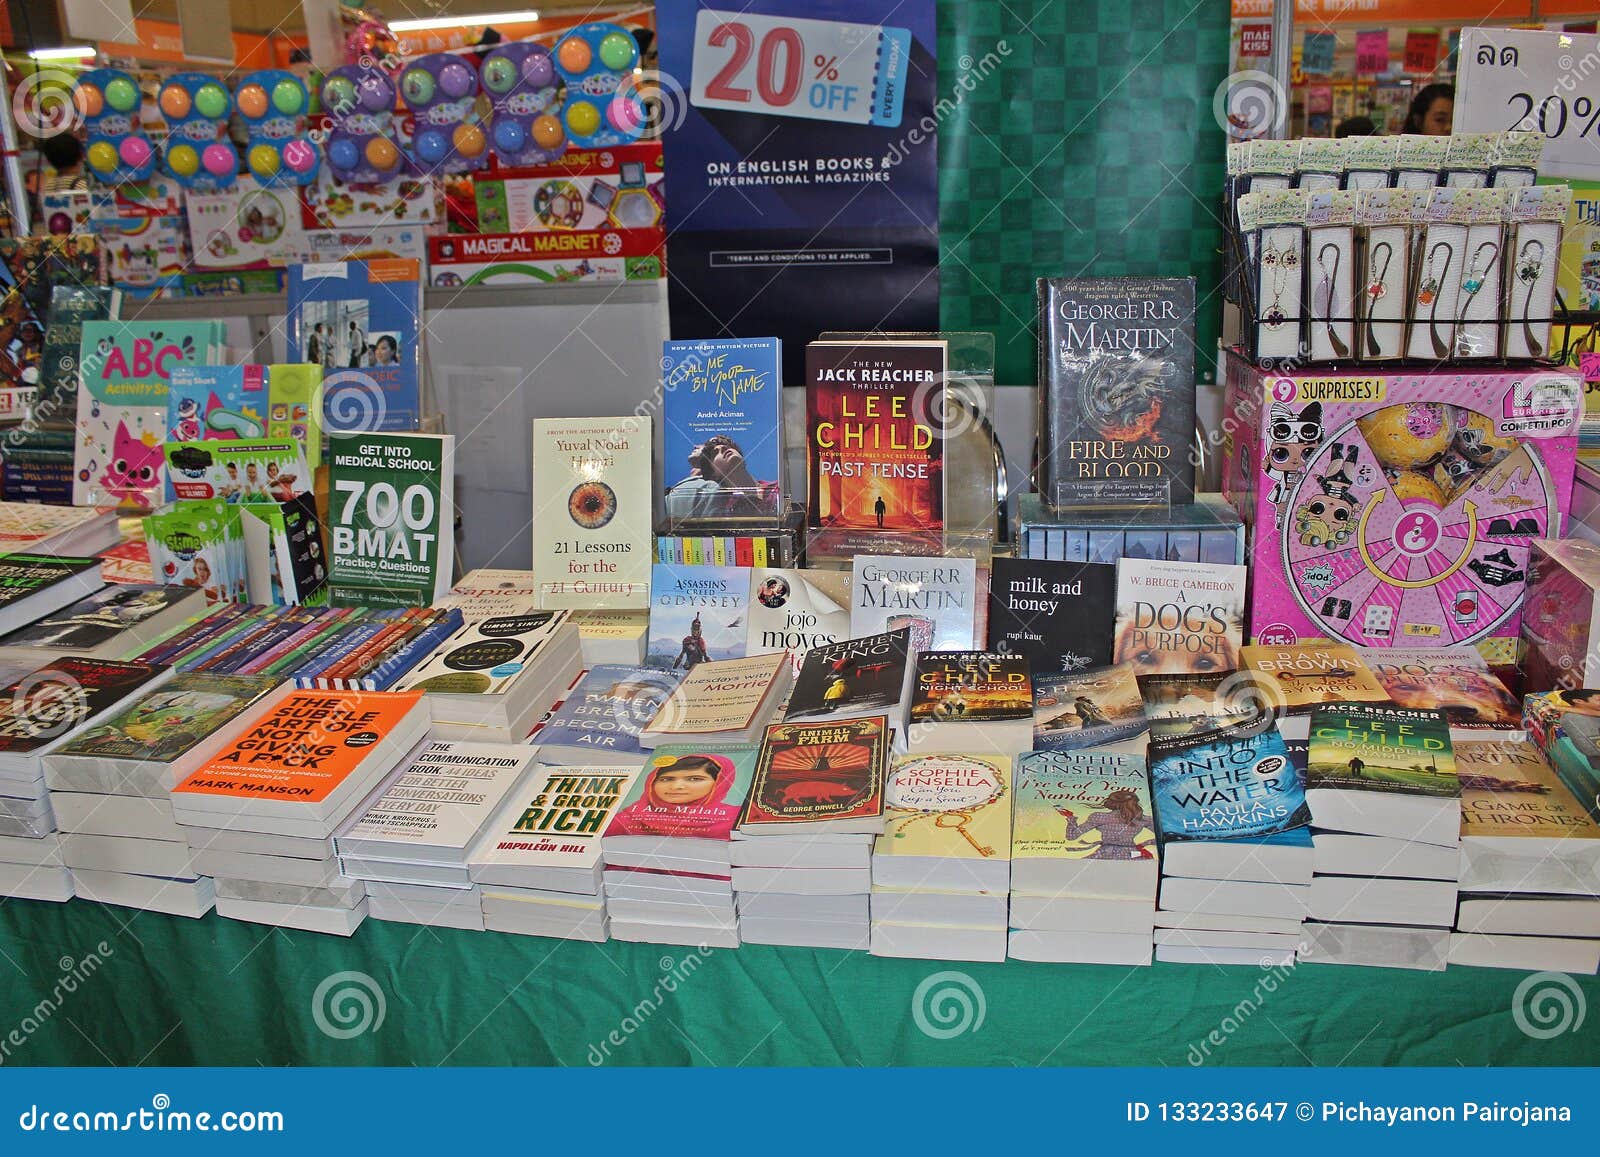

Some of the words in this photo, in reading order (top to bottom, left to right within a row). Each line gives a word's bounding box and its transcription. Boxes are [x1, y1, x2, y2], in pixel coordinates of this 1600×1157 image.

[1477, 45, 1519, 67] ลด
[704, 22, 805, 107] 20
[808, 82, 859, 112] OFF
[883, 82, 895, 118] EVERY
[707, 162, 730, 174] ON
[737, 160, 808, 173] ENGLISH
[816, 157, 874, 171] BOOKS
[708, 175, 810, 186] INTERNATIONAL
[815, 172, 890, 183] MAGAZINES
[463, 236, 532, 255] MAGICAL
[534, 234, 601, 251] MAGNET
[773, 253, 815, 262] CONDITIONS
[1060, 300, 1138, 320] GEORGE
[1066, 322, 1175, 351] MARTIN
[102, 338, 183, 379] ABC
[817, 369, 856, 382] JACK
[862, 370, 934, 382] REACHER
[1302, 381, 1380, 399] SURPRISES!
[842, 395, 906, 418] LEE
[1501, 420, 1548, 431] CONFETTI
[1551, 418, 1572, 428] POP
[816, 422, 933, 450] CHILD
[359, 445, 382, 455] GET
[385, 446, 411, 456] INTO
[556, 439, 591, 451] Yuval
[595, 438, 629, 450] Noah
[1069, 440, 1126, 459] FIRE
[1132, 446, 1171, 459] AND
[335, 455, 385, 468] MEDICAL
[388, 459, 435, 471] SCHOOL
[820, 461, 865, 477] PAST
[872, 462, 929, 479] TENSE
[335, 479, 435, 531] 700
[332, 526, 435, 562] BMAT
[554, 542, 569, 554] 21
[575, 541, 632, 553] Lessons
[334, 556, 376, 569] Practice
[379, 559, 431, 573] Questions
[568, 560, 589, 573] for
[593, 560, 617, 573] the
[862, 565, 930, 584] GEORGE
[573, 581, 633, 599] Century
[1010, 577, 1047, 593] milk
[1052, 580, 1082, 596] and
[1145, 577, 1179, 588] BRUCE
[1183, 580, 1235, 591] CAMERON
[686, 588, 716, 596] CREED
[860, 584, 965, 609] MARTIN
[1176, 589, 1186, 602] A
[660, 594, 741, 608] ODYSSEY
[1009, 594, 1059, 615] honey
[784, 610, 817, 630] jojo
[1135, 601, 1227, 634] DOG'S
[1006, 632, 1023, 641] rupi
[1024, 631, 1042, 640] kaur
[1132, 630, 1225, 655] PURPOSE
[811, 631, 904, 658] STEPHEN
[821, 643, 890, 665] KING
[1277, 652, 1330, 661] DAN
[944, 664, 1002, 673] LEE
[1257, 660, 1362, 672] BROWN
[744, 672, 772, 680] with
[919, 673, 1026, 684] CHILD
[703, 680, 769, 692] Morrie
[1280, 684, 1374, 694] SYMBOL
[290, 697, 341, 709] THE
[275, 708, 380, 722] SUBTLE
[1318, 704, 1362, 713] JACK
[1364, 706, 1441, 720] REACHER
[261, 718, 320, 730] ART
[1345, 719, 1415, 736] LEE
[247, 728, 310, 740] NOT
[577, 734, 616, 746] AIR
[798, 727, 850, 738] ANIMAL
[798, 734, 849, 745] FARM
[1316, 728, 1445, 751] CHILD
[236, 739, 337, 756] GIVING
[430, 743, 454, 752] THE
[1358, 741, 1428, 755] MIDDLE
[219, 751, 239, 762] A
[418, 754, 519, 767] COMMUNICATION
[1036, 752, 1129, 767] SOPHIE
[1179, 750, 1257, 775] INTO
[407, 765, 443, 775] BOOK.
[461, 769, 498, 778] IDEAS
[909, 768, 980, 779] SOPHIE
[1021, 765, 1146, 779] KINSELLA
[1191, 766, 1251, 789] THE
[188, 780, 236, 790] MARK
[239, 783, 315, 796] MANSON
[422, 778, 469, 789] BETTER
[541, 777, 629, 795] THINK
[895, 777, 992, 787] KINSELLA
[386, 788, 487, 803] CONVERSATIONS
[1171, 778, 1286, 808] WATER
[374, 800, 414, 811] EVERY
[414, 803, 442, 813] DAY
[530, 794, 548, 807] &
[551, 794, 621, 809] GROW
[783, 805, 814, 813] GEORGE
[815, 803, 845, 812] ORWELL
[1471, 800, 1548, 812] GAME
[1551, 804, 1569, 812] OF
[643, 805, 668, 813] Am
[673, 805, 727, 816] Malala
[1199, 801, 1267, 818] PAULA
[359, 818, 386, 826] ROMAN
[391, 815, 431, 823] KROGERUS
[513, 808, 609, 834] RICH
[1182, 805, 1289, 830] HAWKINS
[1461, 811, 1592, 827] THRONES
[496, 842, 557, 852] NAPOLEON
[560, 845, 587, 853] HILL
